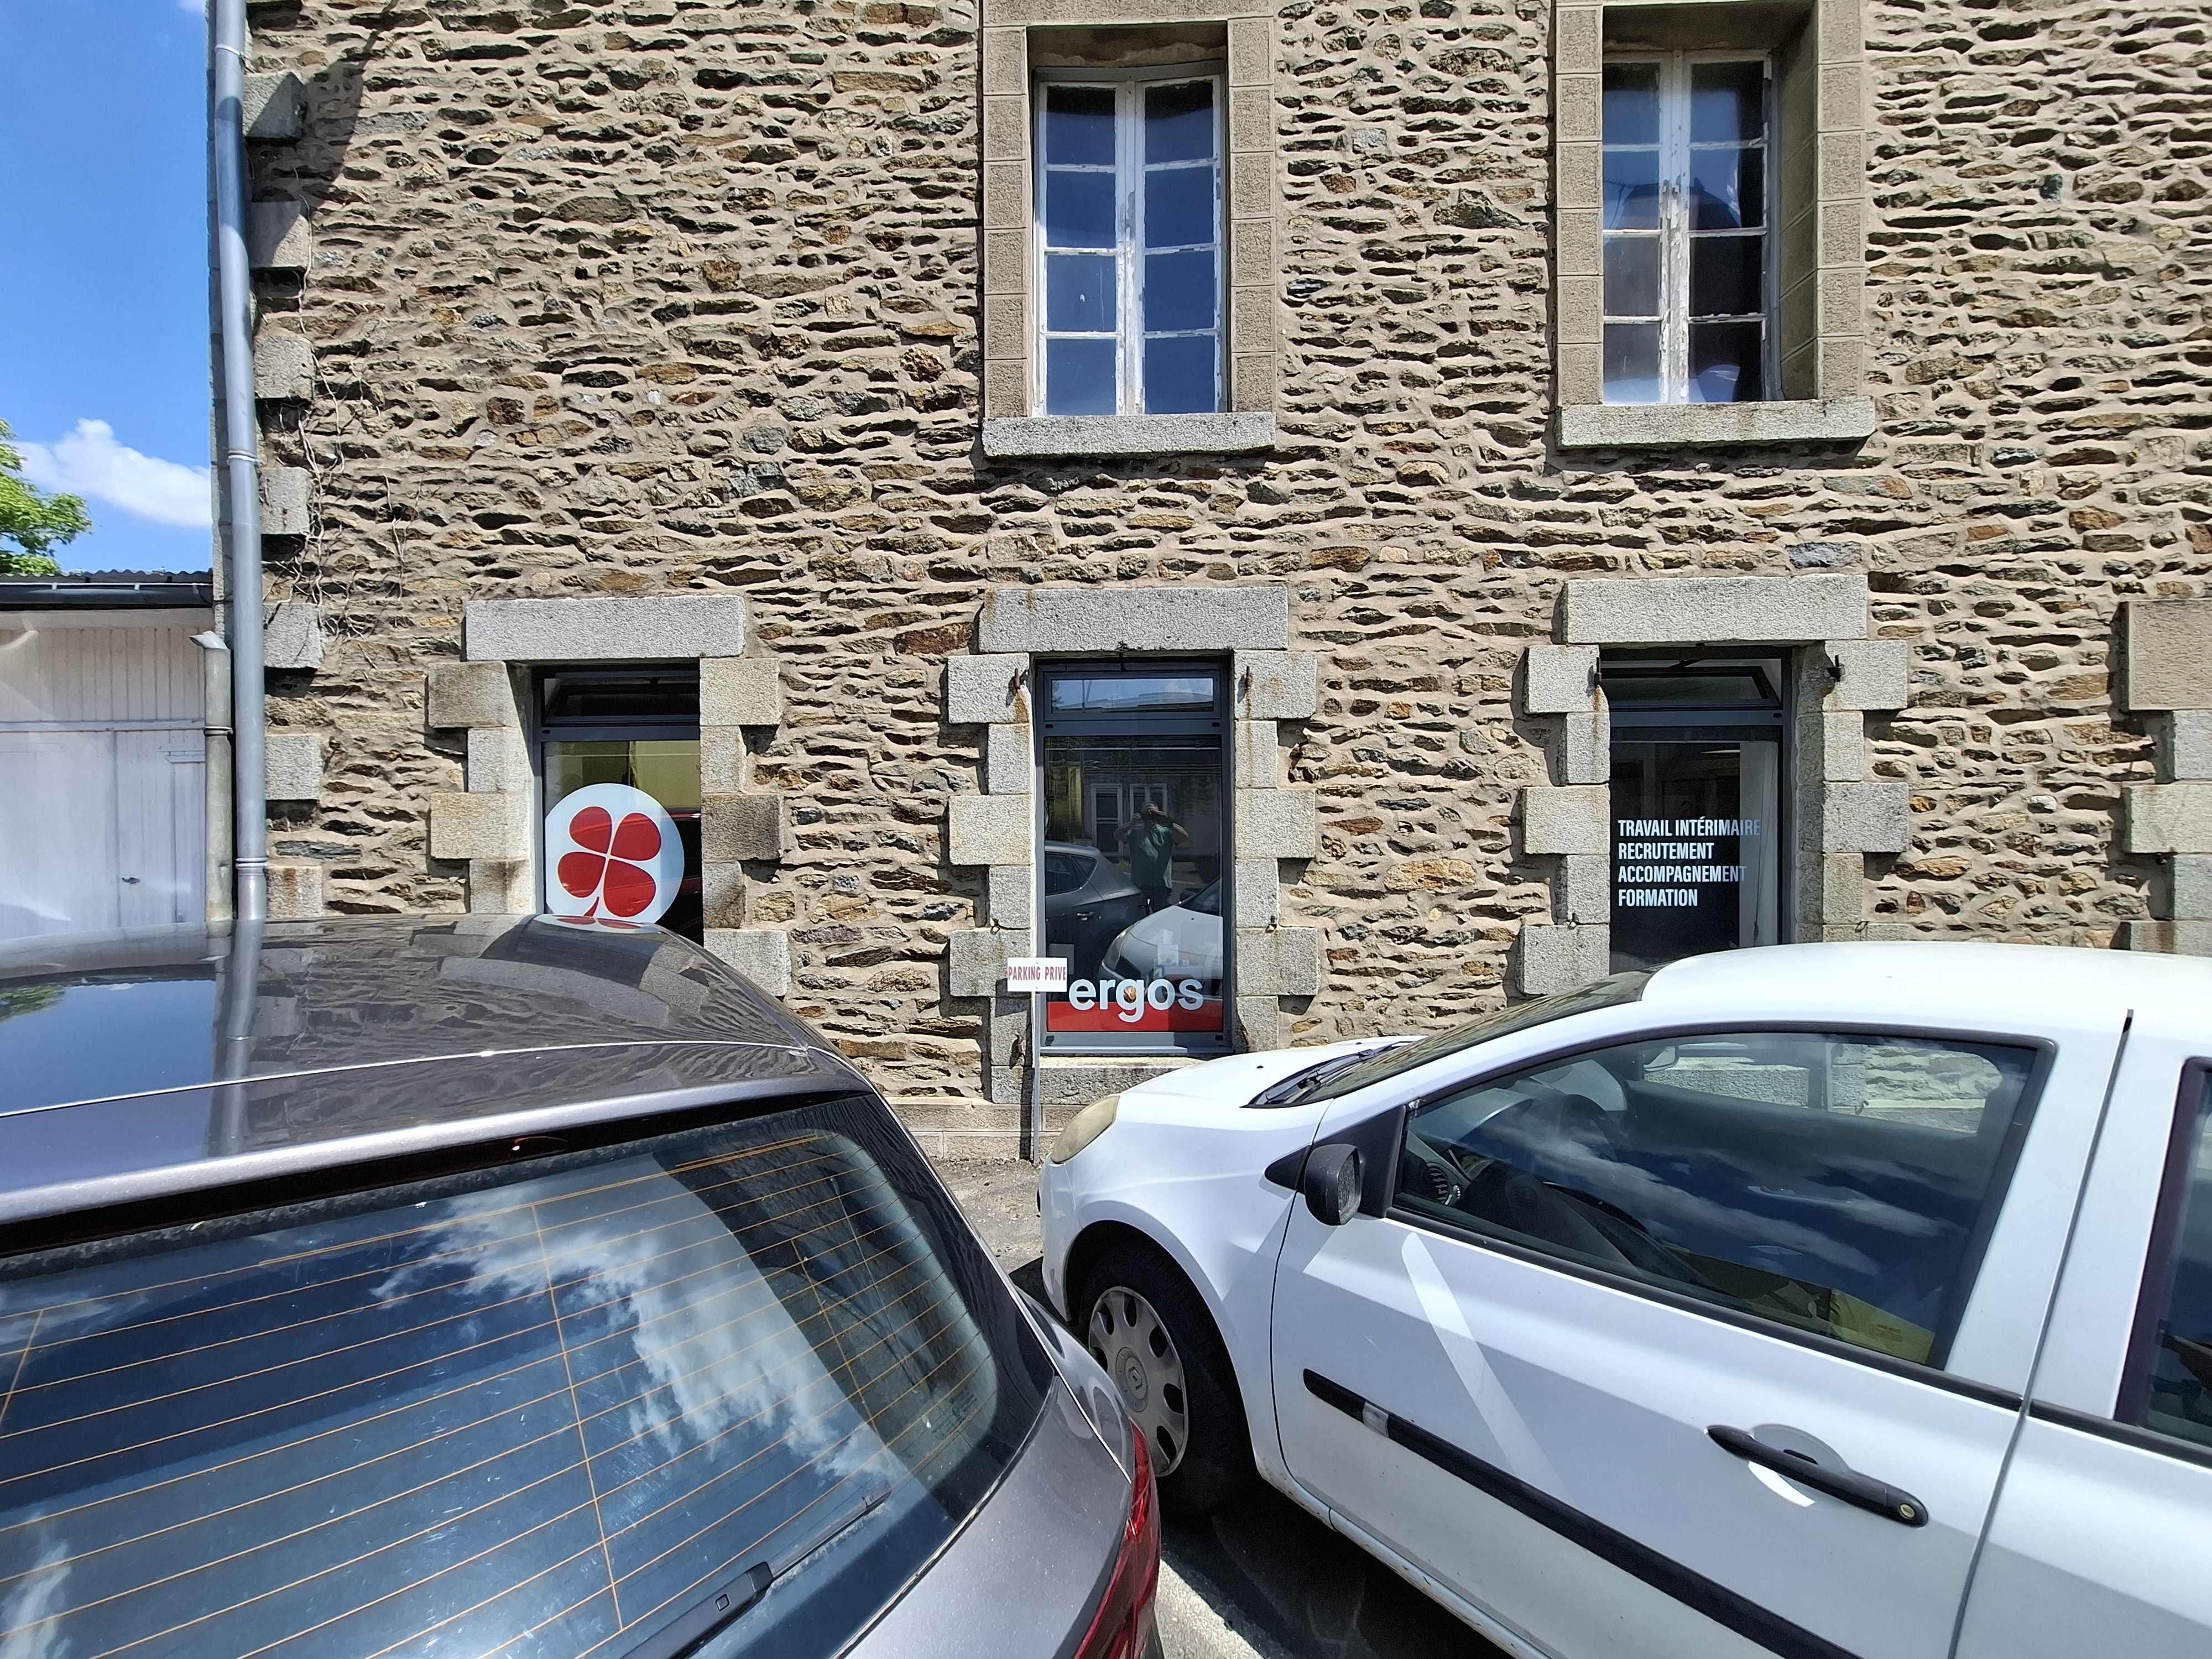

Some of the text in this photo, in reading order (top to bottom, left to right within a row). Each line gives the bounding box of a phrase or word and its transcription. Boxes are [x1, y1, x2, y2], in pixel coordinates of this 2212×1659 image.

[1618, 816, 1761, 837] TRAVAIL INTÉRIMAIRE
[1618, 842, 1714, 859] RECRUTEMENT
[1618, 865, 1747, 883] ACCOMPAGNEMENT
[1618, 889, 1698, 906] FORMATION
[1008, 966, 1066, 980] PARKING PRIVE
[1069, 978, 1204, 1023] ergos
